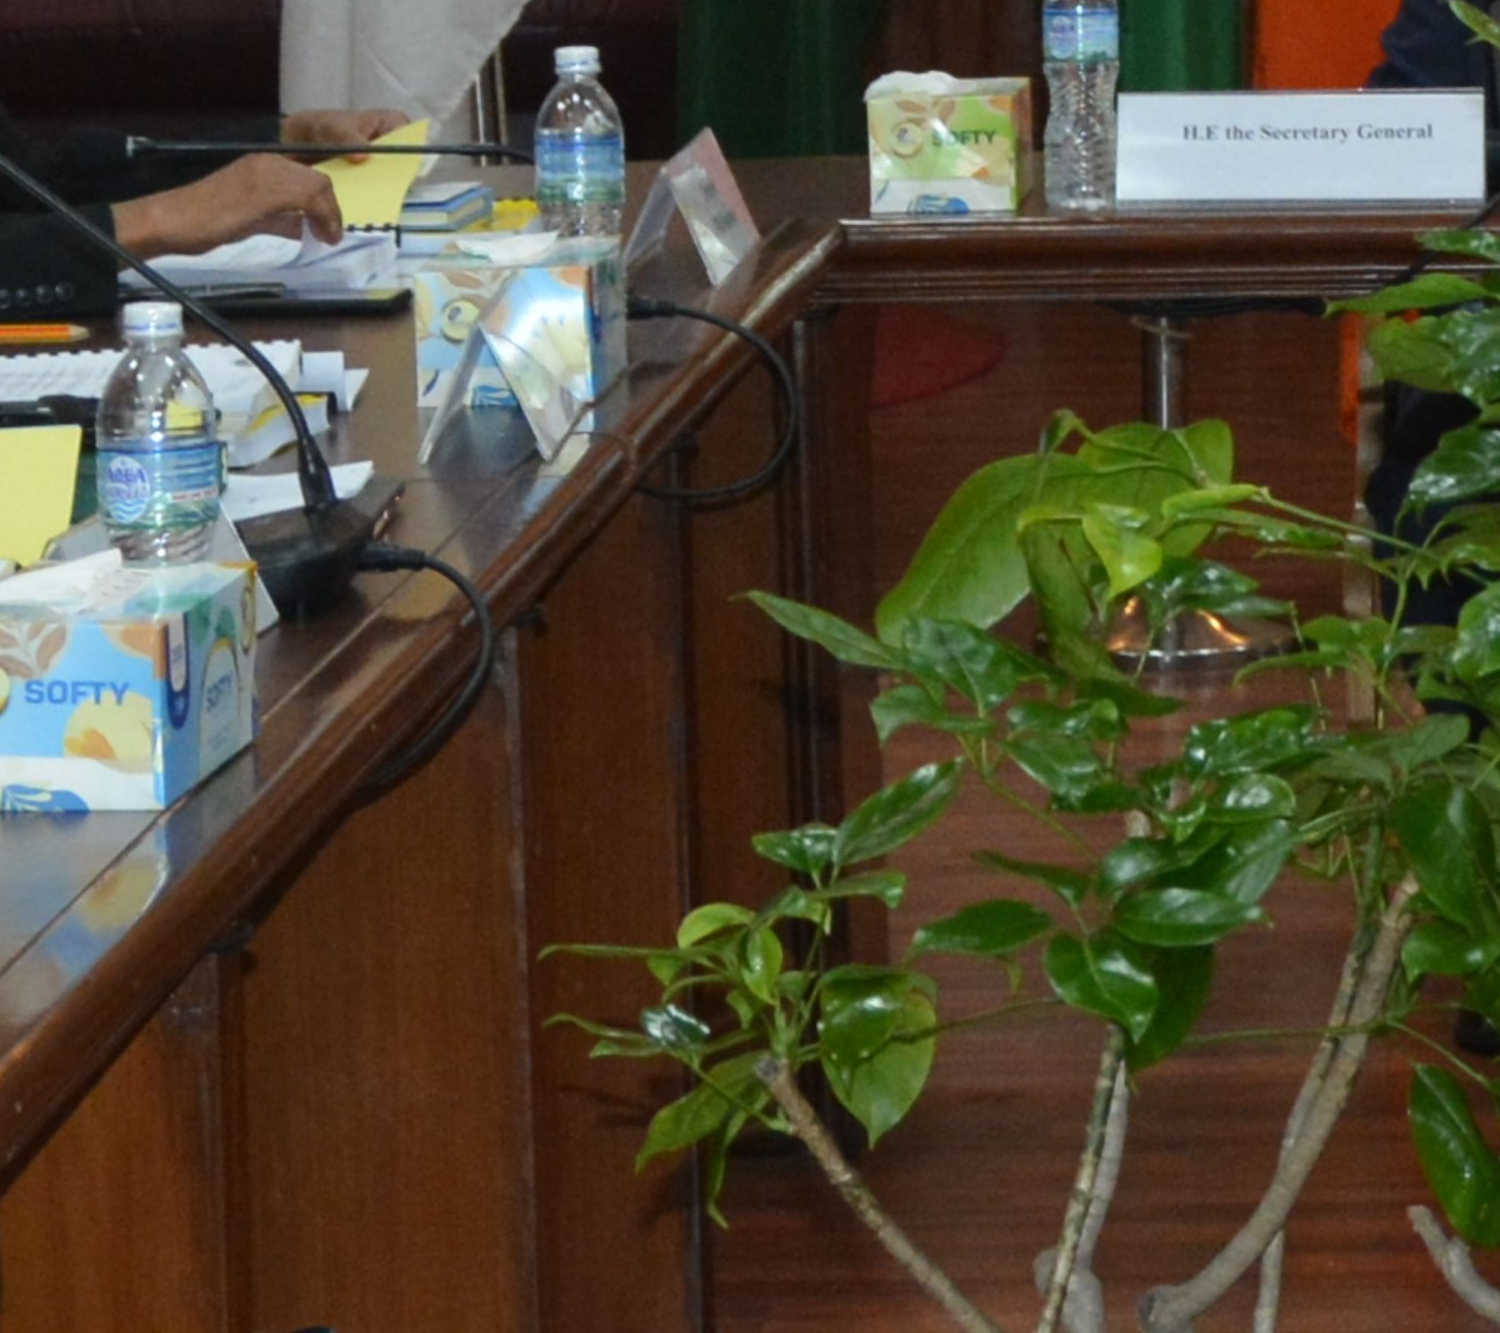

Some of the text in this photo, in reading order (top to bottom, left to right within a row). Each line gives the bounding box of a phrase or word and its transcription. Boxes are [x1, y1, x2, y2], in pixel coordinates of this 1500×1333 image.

[1182, 122, 1434, 144] H.E the Secretary General
[23, 679, 130, 706] SOFTY
